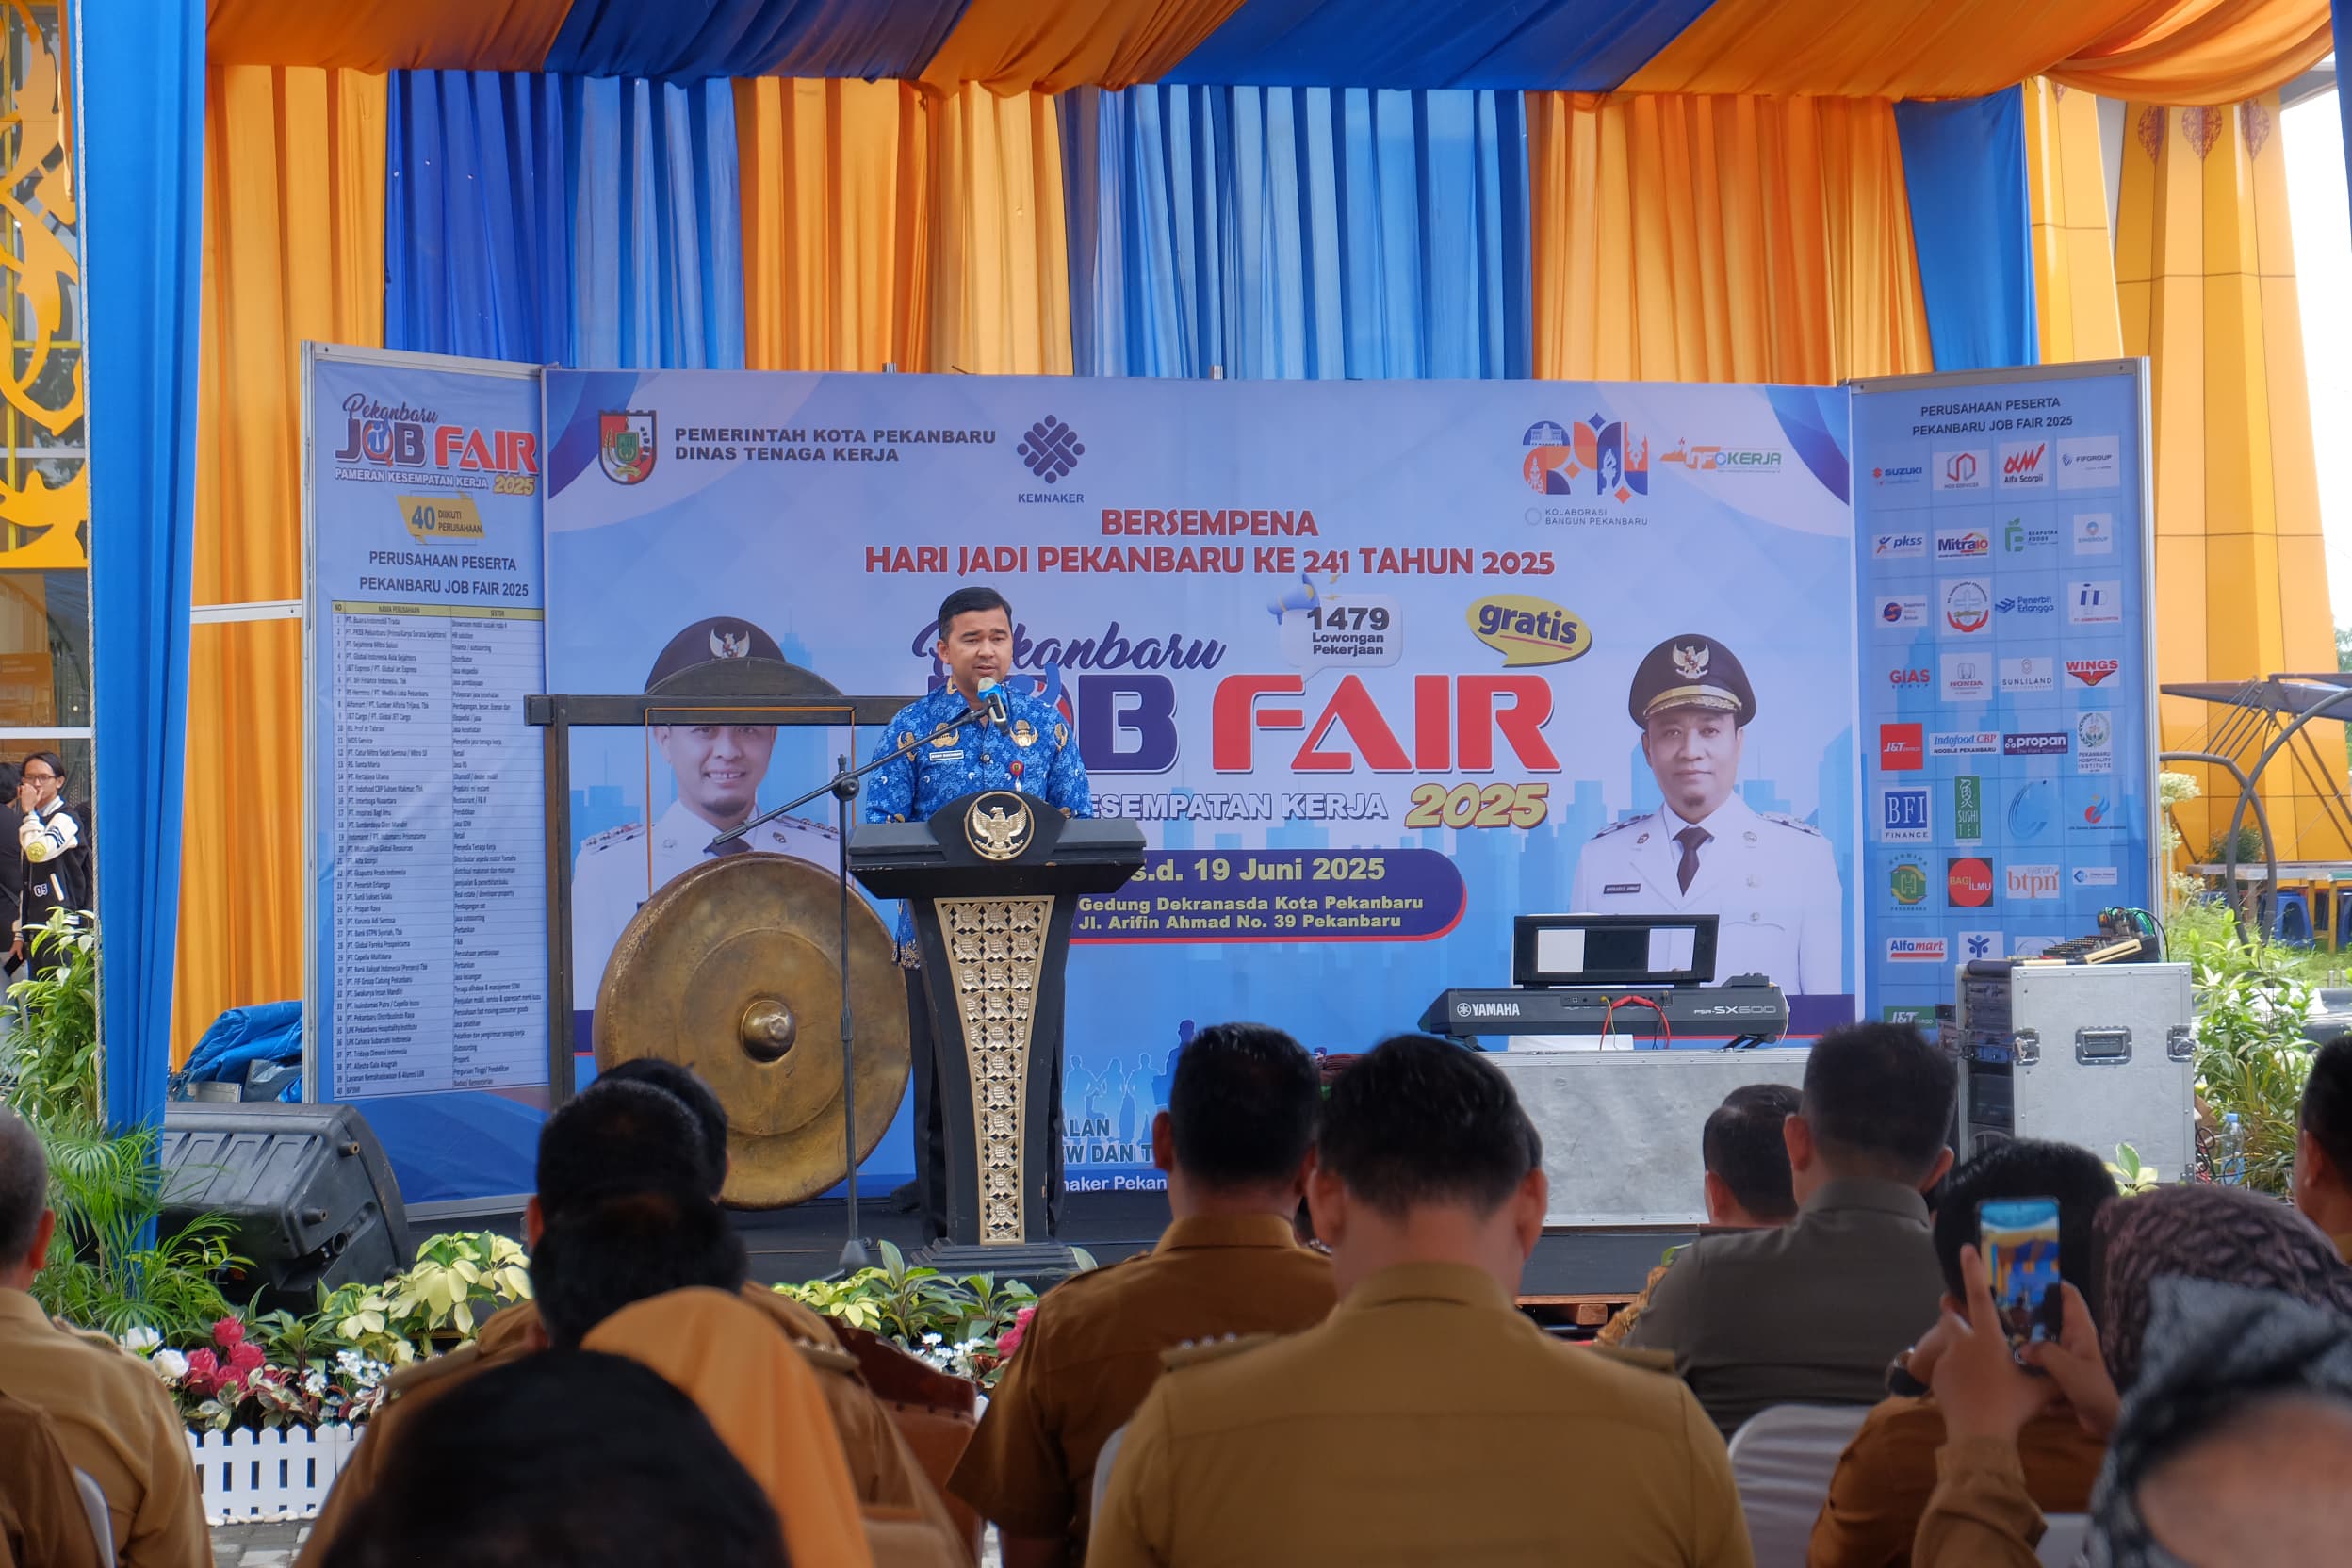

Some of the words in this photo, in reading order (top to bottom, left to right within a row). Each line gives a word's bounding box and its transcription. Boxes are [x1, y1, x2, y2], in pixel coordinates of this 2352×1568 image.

[343, 393, 438, 424] Pekanbaru
[1921, 401, 2001, 416] PERUSAHAAN
[2006, 397, 2060, 411] PESERTA
[1913, 421, 1987, 436] PEKANBARU
[1989, 418, 2013, 431] JOB
[2017, 416, 2043, 430] FAIR
[2047, 416, 2073, 427] 2025
[675, 427, 806, 443] PEMERINTAH
[813, 428, 866, 443] KOTA
[874, 429, 996, 444] PEKANBARU
[335, 418, 425, 467] JOB
[435, 426, 539, 473] FAIR
[675, 446, 737, 461] DINAS
[743, 446, 825, 461] TENAGA
[833, 447, 898, 462] KERJA
[1885, 467, 1922, 476] SUZUKI
[2020, 474, 2043, 483] Scorpii
[335, 468, 385, 482] PAMERAN
[387, 470, 454, 487] KESEMPATAN
[457, 477, 489, 489] KERJA
[493, 474, 535, 496] 2025
[1018, 493, 1085, 504] KEMNAKER
[411, 506, 435, 530] 40
[1546, 508, 1607, 516] KOLABORASI
[438, 523, 482, 533] PERUSAHAAN
[1102, 509, 1319, 536] BERSEMPENA
[1546, 517, 1586, 526] BANGUN
[1590, 517, 1648, 526] PEKANBARU
[1894, 535, 1922, 548] pkss
[1938, 538, 1988, 551] Mitra10
[369, 551, 457, 568] PERUSAHAAN
[462, 556, 516, 571] PESERTA
[866, 546, 948, 573] HARI
[957, 546, 1028, 577] JADI
[1037, 546, 1244, 573] PEKANBARU
[1254, 547, 1295, 573] KE
[1303, 550, 1349, 574] 241
[1359, 547, 1473, 574] TAHUN
[1481, 550, 1556, 575] 2025
[360, 577, 441, 593] PEKANBARU
[445, 580, 468, 594] JOB
[473, 581, 498, 596] FAIR
[502, 583, 529, 596] 2025
[2017, 604, 2054, 613] Erlangga
[1307, 607, 1390, 631] 1479
[1478, 605, 1577, 644] gratis
[1313, 632, 1384, 645] Lowongan
[1314, 645, 1383, 657] Pekerjaan
[2066, 660, 2118, 671] WINGS
[1889, 669, 1930, 684] GIAS
[1213, 675, 1561, 775] FAIR
[1884, 743, 1906, 752] J&T
[1934, 735, 1974, 747] Indofood
[1977, 734, 1997, 743] CBP
[2017, 736, 2066, 747] propan
[1091, 793, 1274, 821] ESEMPATAN
[1281, 792, 1389, 821] KERJA
[1404, 783, 1549, 828] 2025
[1887, 796, 1926, 824] BFI
[1958, 810, 1978, 823] SUSHI
[1194, 858, 1230, 881] 19
[1240, 858, 1302, 881] Juni
[1313, 858, 1385, 880] 2025
[1950, 876, 1971, 885] BAGI
[1079, 897, 1150, 913] Gedung
[1157, 896, 1268, 911] Dekranasda
[1275, 896, 1318, 910] Kota
[1325, 895, 1423, 910] Pekanbaru
[1079, 916, 1102, 930] Jl.
[1108, 915, 1159, 929] Arifin
[1168, 915, 1230, 928] Ahmad
[1237, 914, 1267, 928] No.
[1274, 914, 1296, 928] 39
[1303, 913, 1401, 928] Pekanbaru
[1891, 940, 1944, 951] Alfamart
[1471, 1002, 1520, 1017] YAMAHA
[1891, 1012, 1919, 1023] J&T
[1092, 1144, 1134, 1162] DAN
[1141, 1144, 1153, 1162] T
[1114, 1176, 1167, 1190] Pekan
